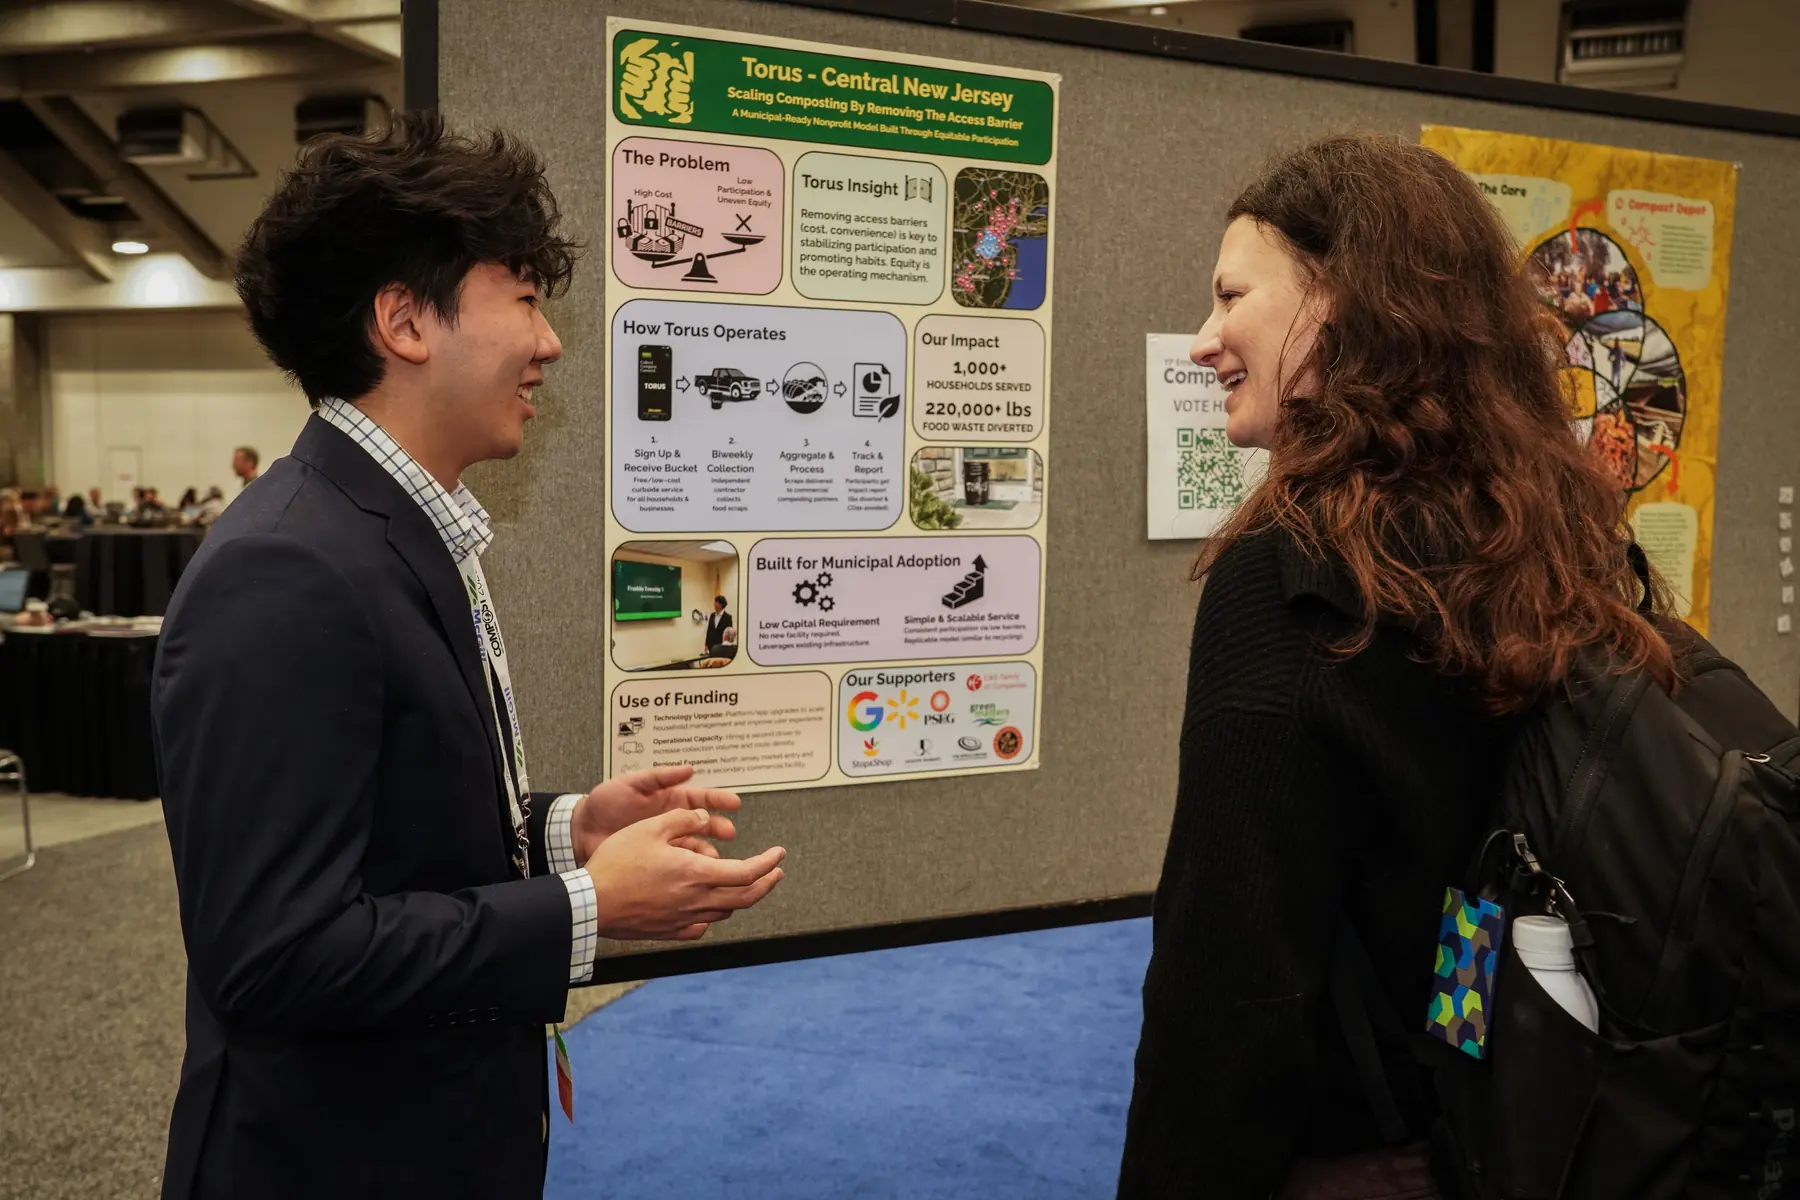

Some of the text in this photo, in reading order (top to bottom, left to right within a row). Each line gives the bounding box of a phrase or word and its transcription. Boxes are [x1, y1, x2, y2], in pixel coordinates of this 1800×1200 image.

[741, 56, 803, 83] Torus
[821, 66, 900, 94] Central
[903, 76, 949, 100] New
[950, 83, 1014, 113] Jersey
[727, 87, 1024, 130] Scaling Composting By Removing The Access Barrier
[732, 109, 1020, 147] A Municipal-Ready Nonprofit Model Built Through Equitable Participation
[622, 149, 730, 172] The Problem
[736, 176, 753, 185] Low
[801, 174, 899, 198] Torus Insight
[634, 188, 673, 199] High Cost
[717, 185, 772, 197] Participation &
[717, 195, 772, 209] Uneven Equity
[801, 208, 928, 228] Removing access barriers
[666, 218, 702, 236] BARRIERS
[830, 226, 897, 240] convenience)
[898, 230, 906, 240] is
[908, 231, 926, 244] key
[927, 233, 938, 242] to
[800, 238, 937, 256] stabilizing participation and
[799, 252, 853, 266] promoting
[890, 257, 921, 271] Equity
[922, 259, 931, 269] is
[799, 265, 928, 283] the operating mechanism.
[623, 320, 787, 342] How Torus Operates
[921, 332, 1000, 351] Our Impact
[953, 361, 1007, 377] 1,000+
[1164, 367, 1216, 389] Comp
[643, 382, 667, 390] TORUS
[926, 380, 1032, 392] HOUSEHOLDS SERVED
[925, 401, 1032, 418] 220,000+ lbs
[1173, 399, 1209, 412] VOTE
[922, 421, 1034, 433] FOOD WASTE DIVERTED
[634, 448, 681, 460] Sign Up &
[711, 450, 753, 461] Biweekly
[779, 451, 835, 461] Aggregate &
[852, 451, 883, 460] Track &
[624, 463, 698, 473] Receive Bucket
[707, 464, 754, 473] Collection
[790, 465, 825, 474] Process
[854, 465, 884, 475] Report
[756, 554, 961, 572] Built for Municipal Adoption
[759, 617, 880, 630] Low Capital Requirement
[904, 612, 1020, 626] Simple & Scalable Service
[759, 632, 769, 640] No
[786, 631, 810, 639] facility
[758, 641, 822, 650] Leverages existing
[846, 670, 956, 688] Our Supporters
[619, 690, 738, 708] Use of Funding
[503, 686, 520, 738] McGill
[969, 703, 996, 713] green
[653, 714, 692, 722] Technology
[924, 713, 956, 725] PSEG
[652, 736, 693, 745] Operational
